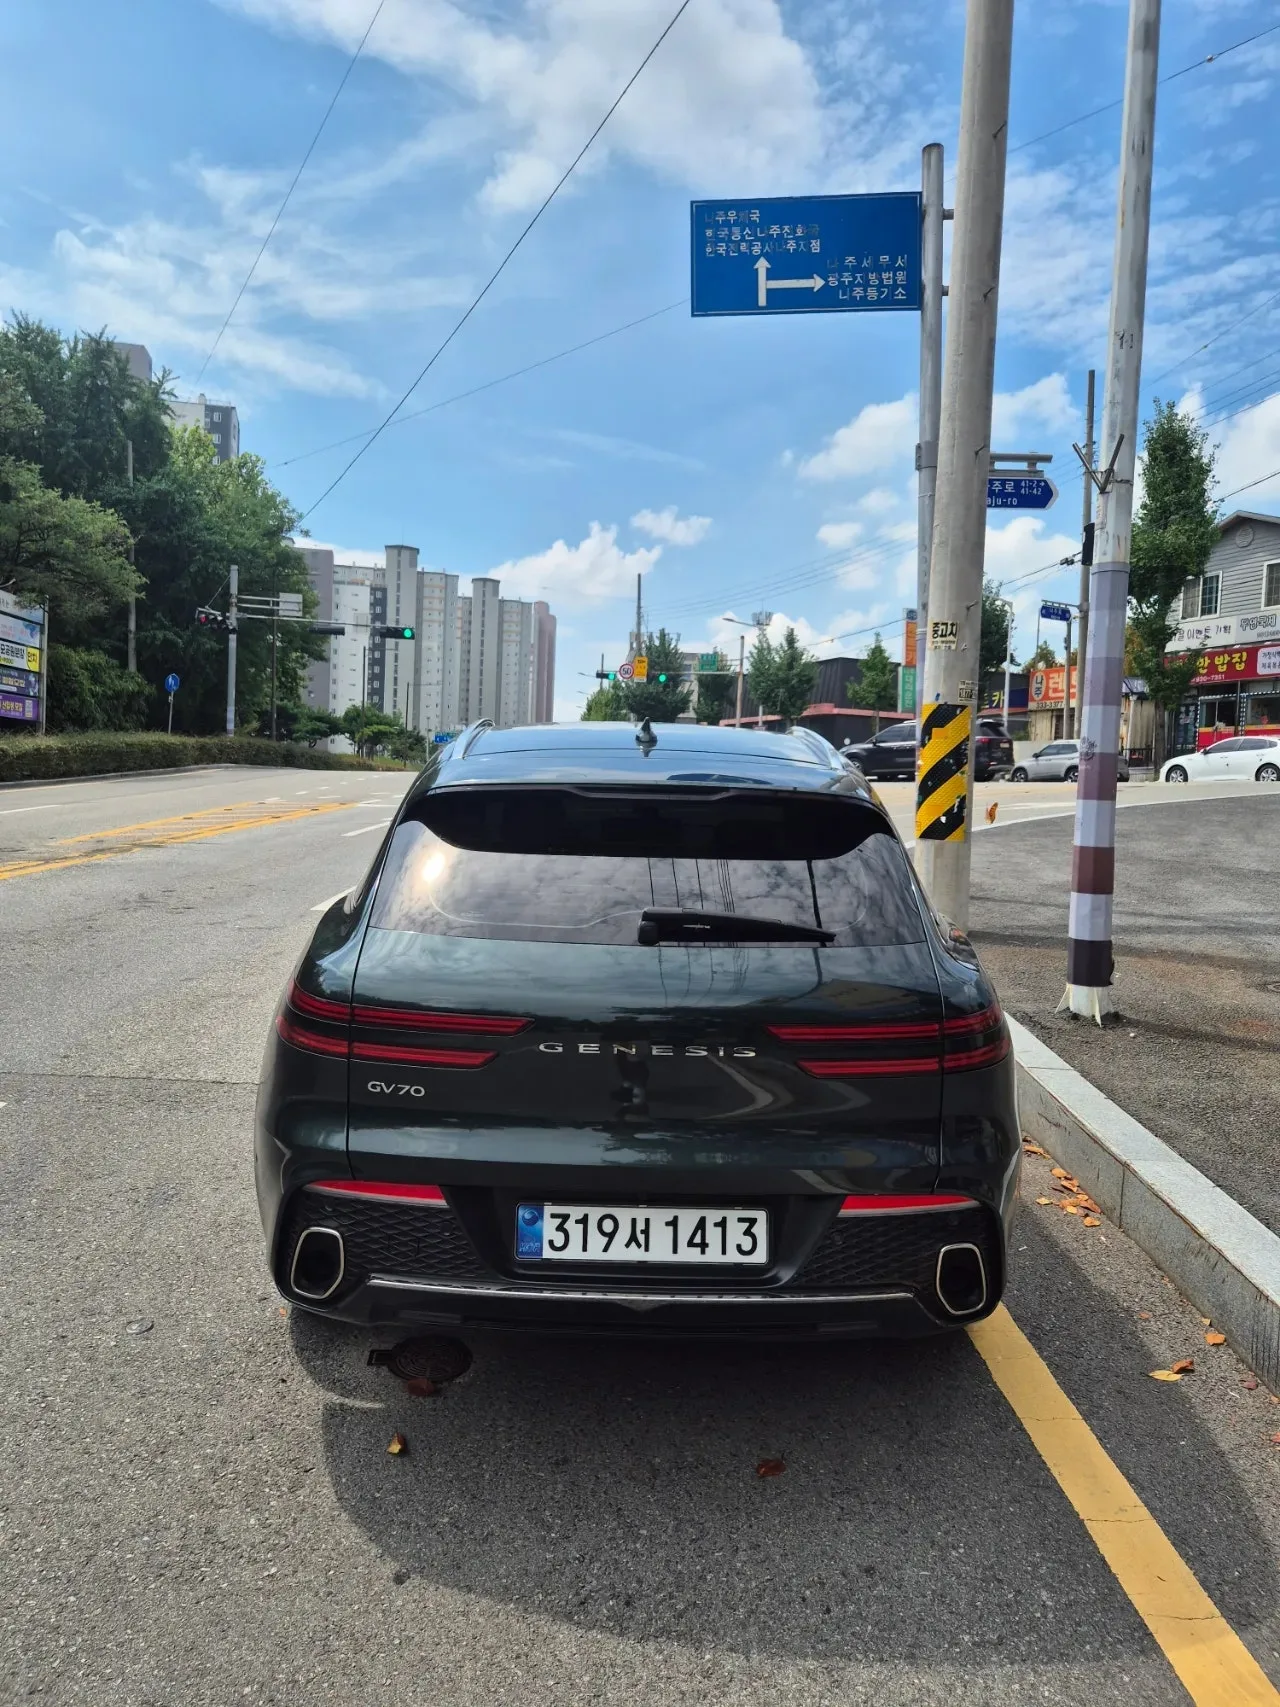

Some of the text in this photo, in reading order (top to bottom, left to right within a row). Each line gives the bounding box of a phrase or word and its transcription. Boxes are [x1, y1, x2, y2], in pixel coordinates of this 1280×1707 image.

[988, 481, 1016, 493] 주로
[539, 1042, 757, 1057] GENESIS
[367, 1080, 426, 1097] GV70
